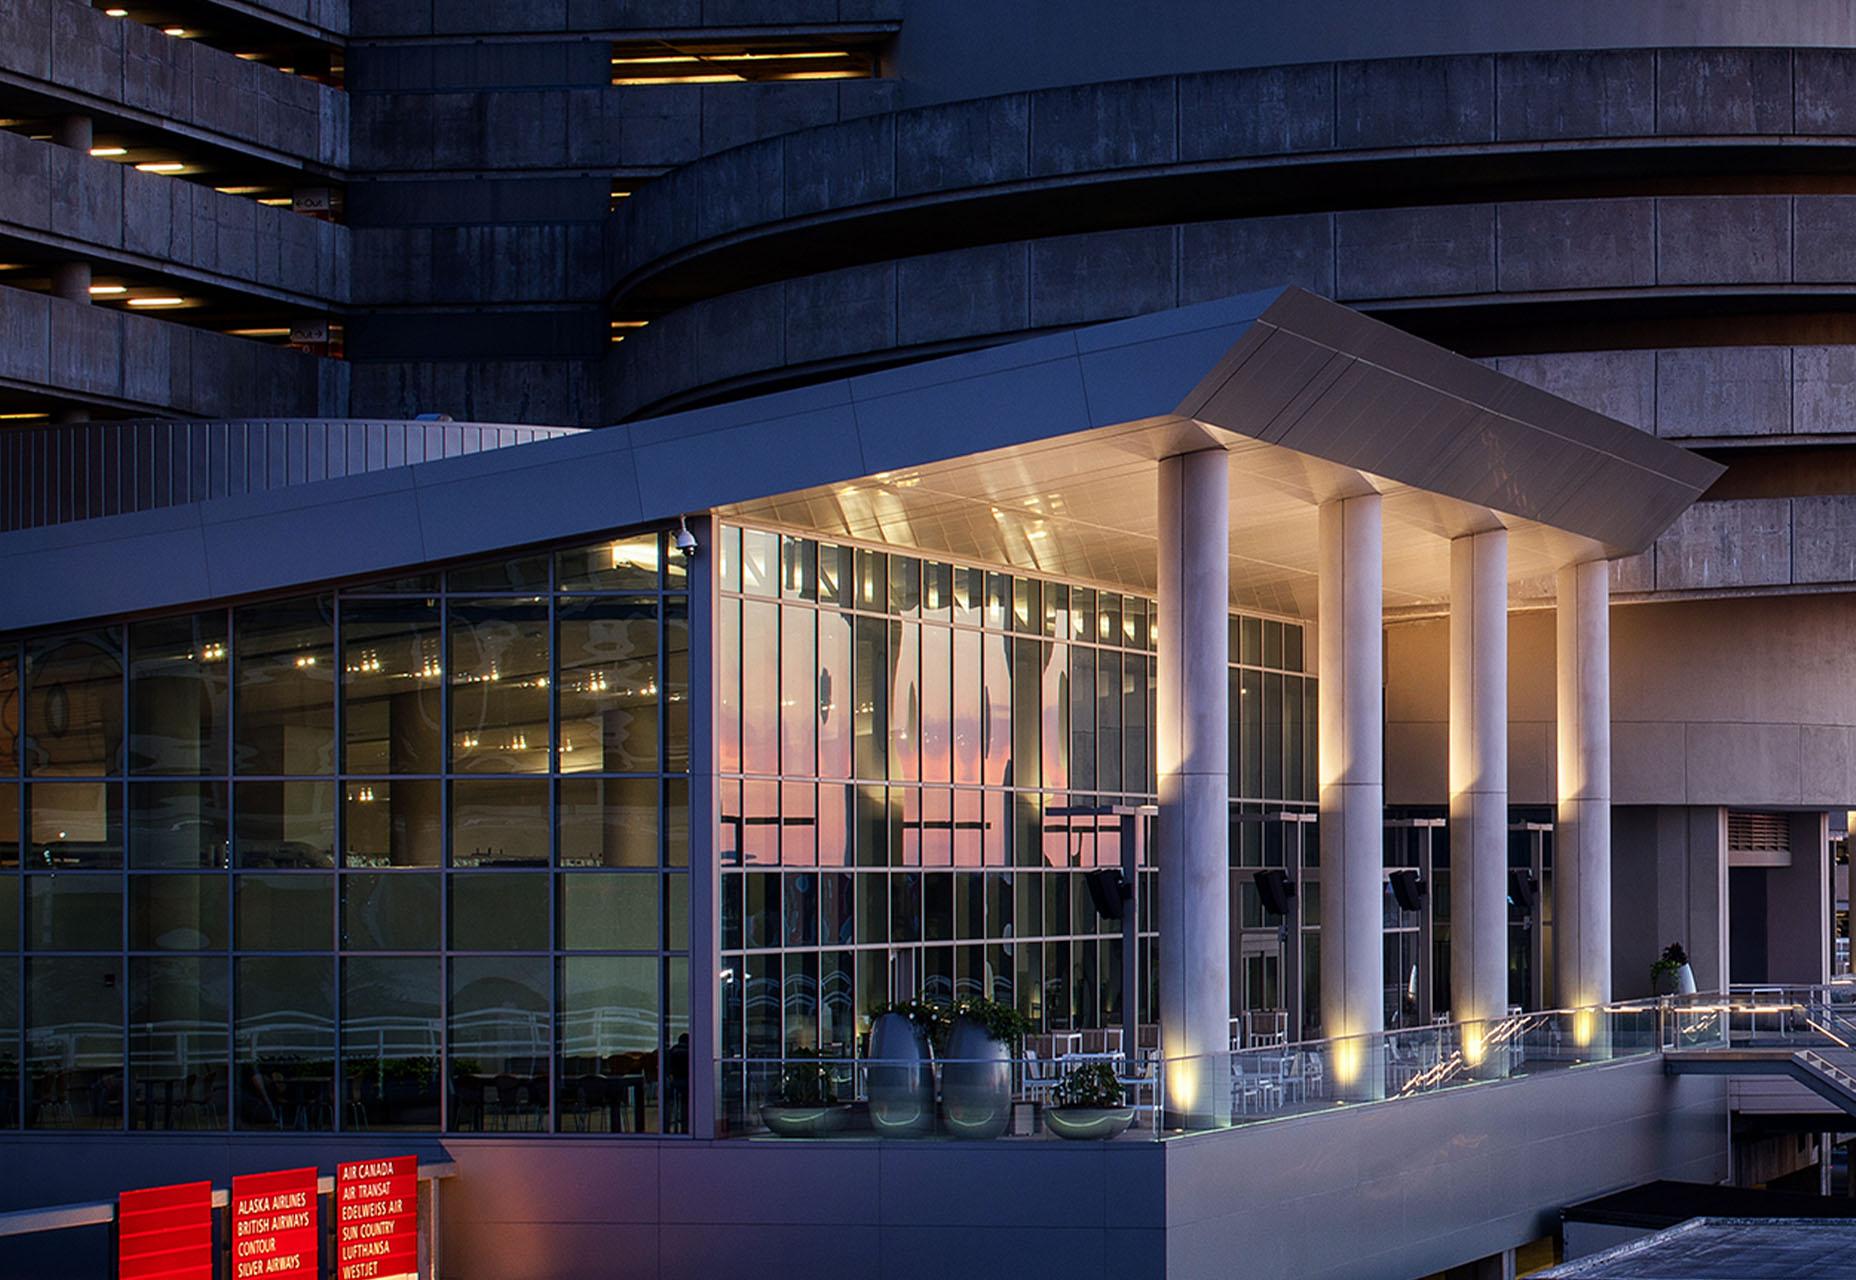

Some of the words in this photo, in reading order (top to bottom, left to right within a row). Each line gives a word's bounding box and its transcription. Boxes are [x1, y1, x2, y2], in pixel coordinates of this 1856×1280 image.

[343, 1166, 357, 1180] AIR
[359, 1162, 394, 1179] CANADA
[343, 1186, 356, 1200] AIR
[358, 1181, 391, 1198] TRANSAT
[238, 1197, 270, 1215] ALASKA
[272, 1192, 306, 1210] AIRLINES
[342, 1201, 386, 1220] EDELWEISS
[388, 1199, 403, 1214] AIR
[238, 1218, 269, 1236] BRITISH
[271, 1211, 310, 1231] AIRWAYS
[343, 1225, 358, 1241] SUN
[360, 1220, 395, 1238] COUNTRY
[238, 1237, 276, 1257] CONTOUR
[343, 1240, 390, 1261] LUFTHANSA
[238, 1259, 263, 1278] SILVER
[265, 1254, 300, 1273] AIRWAYS
[343, 1261, 378, 1279] WESTJET
